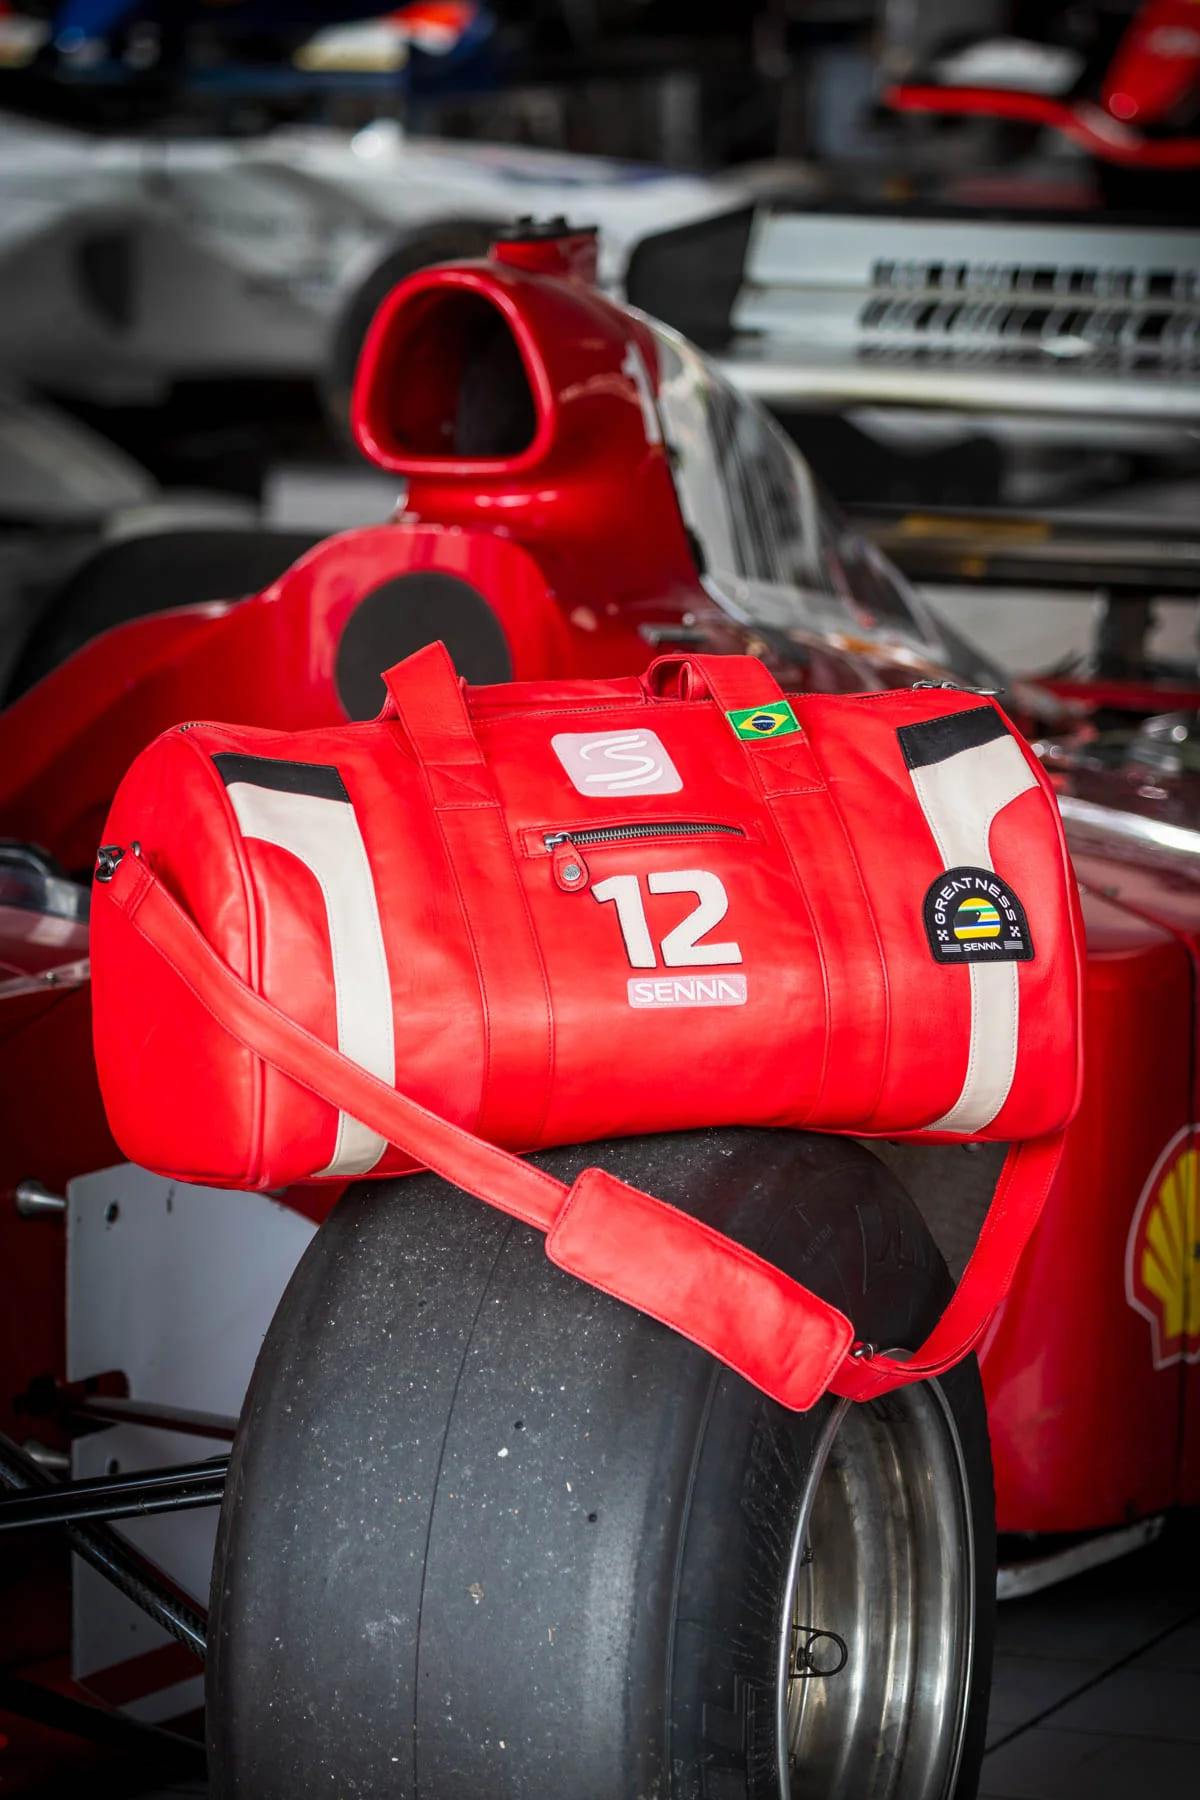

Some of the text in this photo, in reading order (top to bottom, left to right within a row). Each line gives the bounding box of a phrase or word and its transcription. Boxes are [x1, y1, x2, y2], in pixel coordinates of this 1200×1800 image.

[590, 869, 744, 969] 12
[934, 877, 1017, 925] GREATNESS
[963, 942, 1002, 952] SENNA
[634, 979, 740, 1003] SENNA
